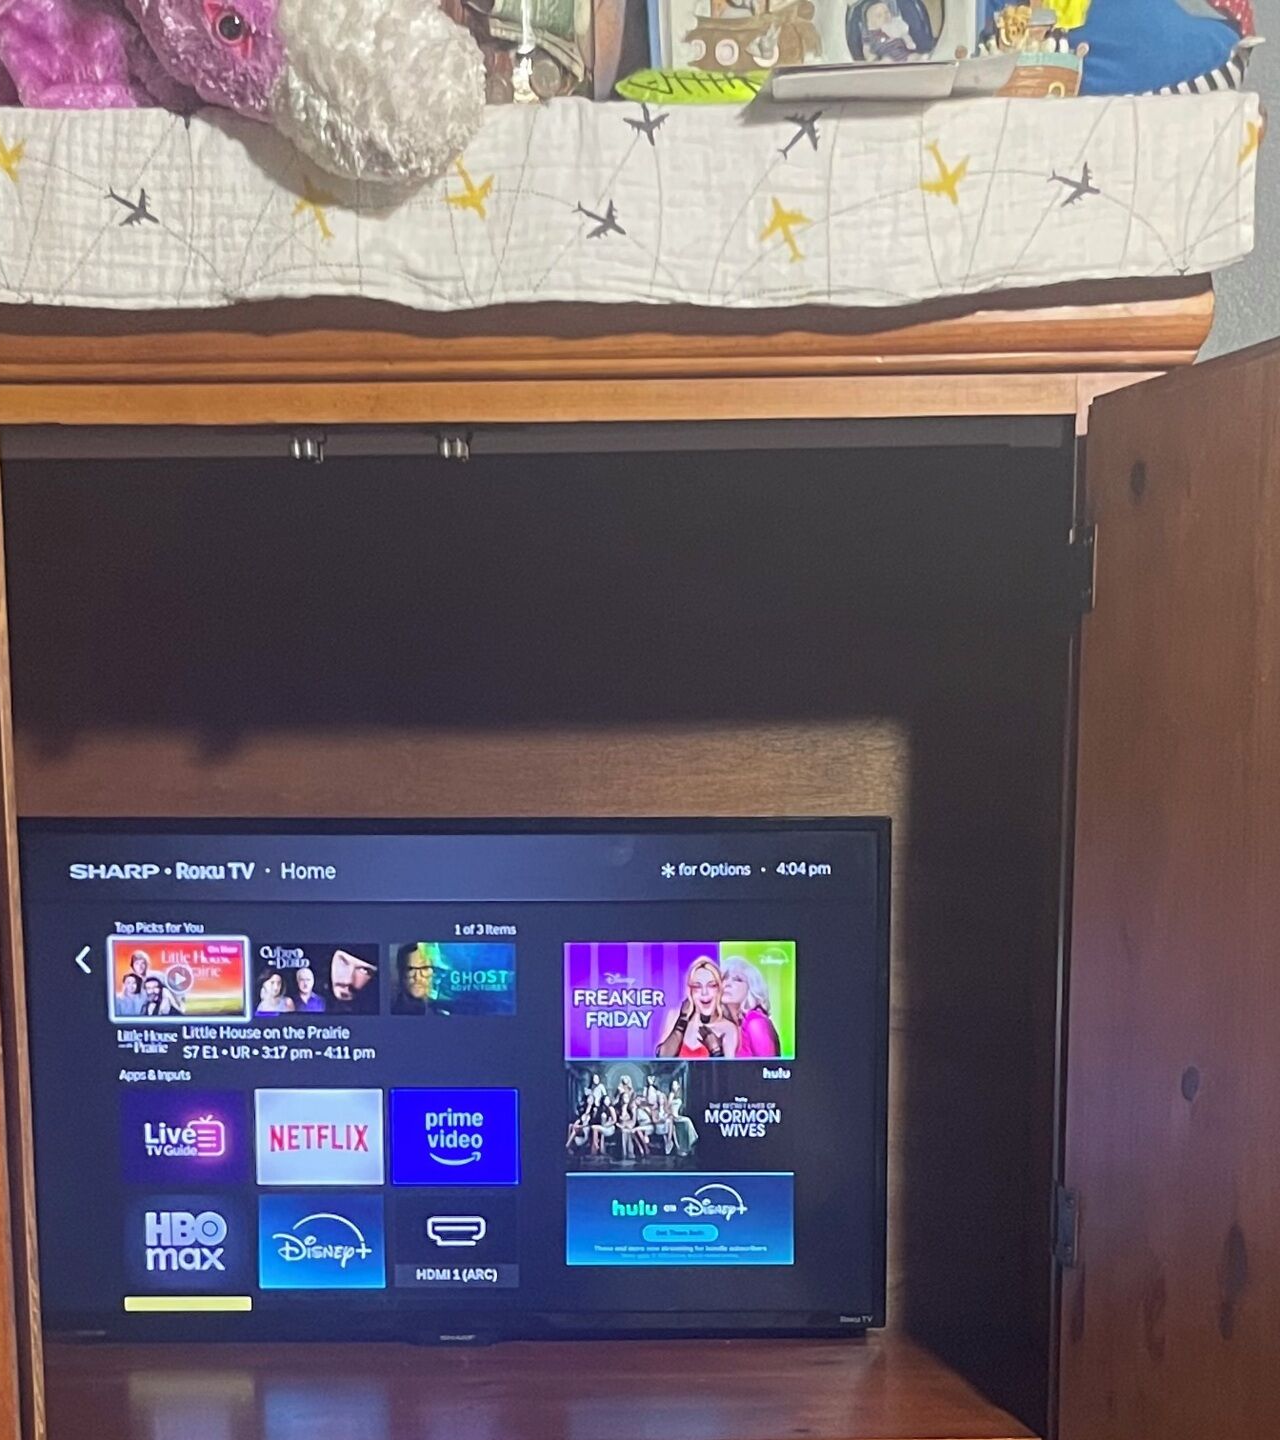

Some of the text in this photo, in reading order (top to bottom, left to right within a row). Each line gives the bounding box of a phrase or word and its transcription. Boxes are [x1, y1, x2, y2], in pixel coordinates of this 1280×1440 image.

[69, 863, 161, 880] SHARP
[227, 861, 256, 880] TV
[280, 861, 337, 880] Home
[678, 861, 832, 878] for Options 4:04 pm
[114, 921, 205, 934] Top Picks for You
[454, 924, 461, 935] 1
[463, 923, 475, 935] of
[476, 924, 484, 935] 3
[450, 970, 509, 984] GHOST
[573, 989, 665, 1007] FREAKIER
[585, 1010, 653, 1029] FRIDAY
[182, 1025, 351, 1040] Little House on the Prairie
[183, 1045, 200, 1060] S7
[201, 1045, 219, 1059] E1
[230, 1045, 251, 1059] UR
[261, 1046, 288, 1059] 3:17
[289, 1048, 314, 1061] pm
[323, 1046, 351, 1059] 4:11
[352, 1048, 376, 1061] pm
[118, 1068, 192, 1082] Apps & Inputs
[762, 1066, 791, 1079] hulu
[425, 1107, 484, 1130] prime
[704, 1108, 781, 1124] MORMON
[144, 1123, 196, 1146] Live
[269, 1124, 369, 1152] NETFLIX
[427, 1128, 484, 1149] video
[720, 1122, 767, 1138] WIVES
[145, 1145, 198, 1157] TV Guide
[611, 1199, 658, 1217] hulu
[679, 1193, 749, 1222] Disney+
[145, 1210, 228, 1247] HBO
[271, 1230, 373, 1269] Disney+
[145, 1246, 226, 1272] max
[415, 1268, 498, 1283] HDMI 1 (ARC)
